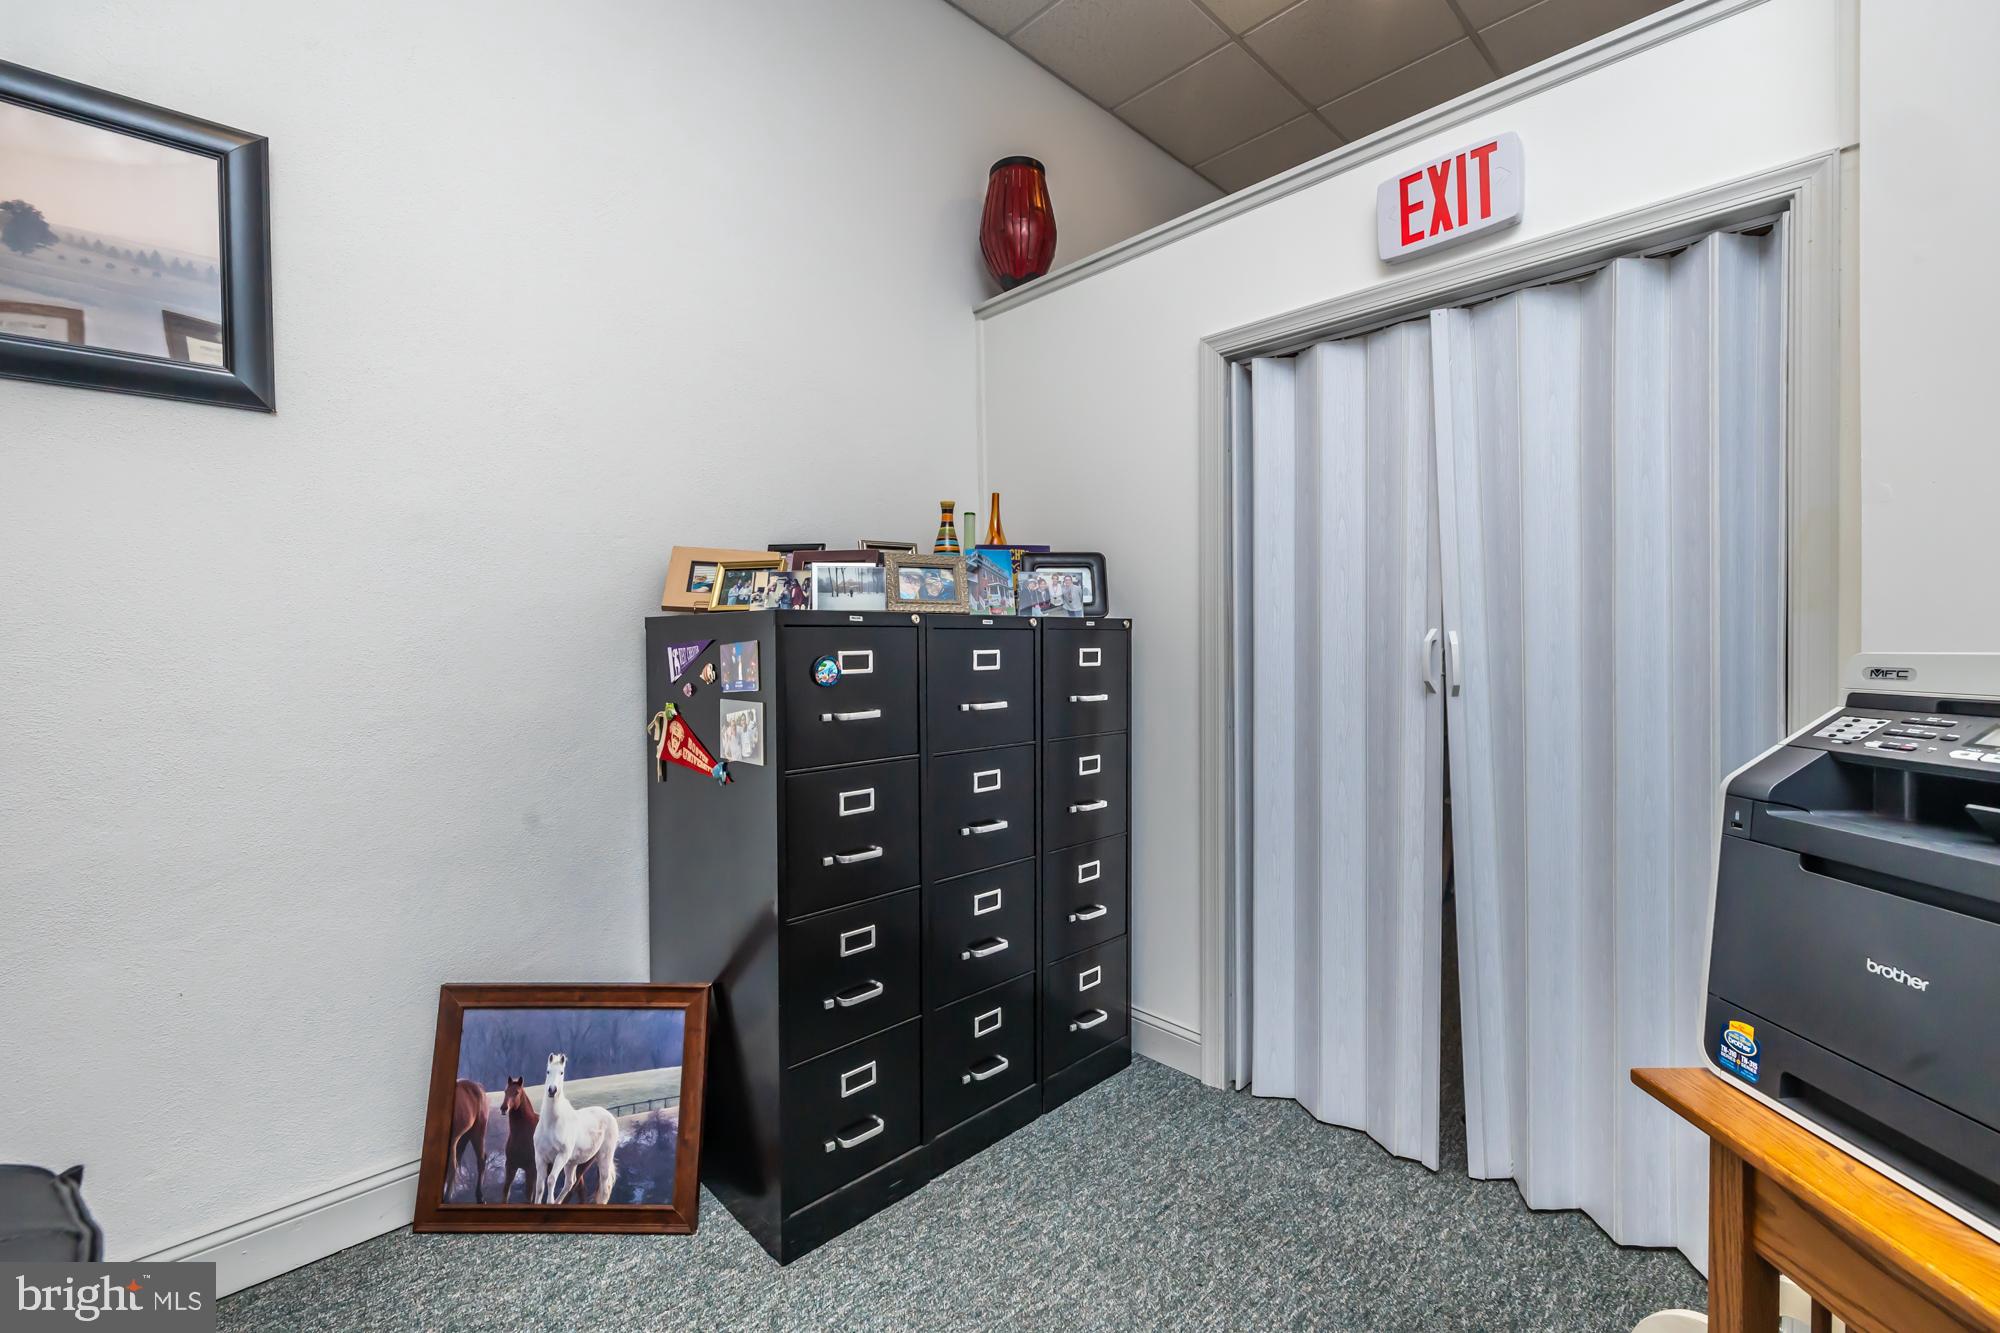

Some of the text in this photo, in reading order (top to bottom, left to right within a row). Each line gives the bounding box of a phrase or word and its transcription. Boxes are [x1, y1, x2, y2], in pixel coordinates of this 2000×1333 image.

[1399, 141, 1498, 247] EXIT
[1870, 668, 1909, 678] MFC
[1866, 958, 1929, 992] brother
